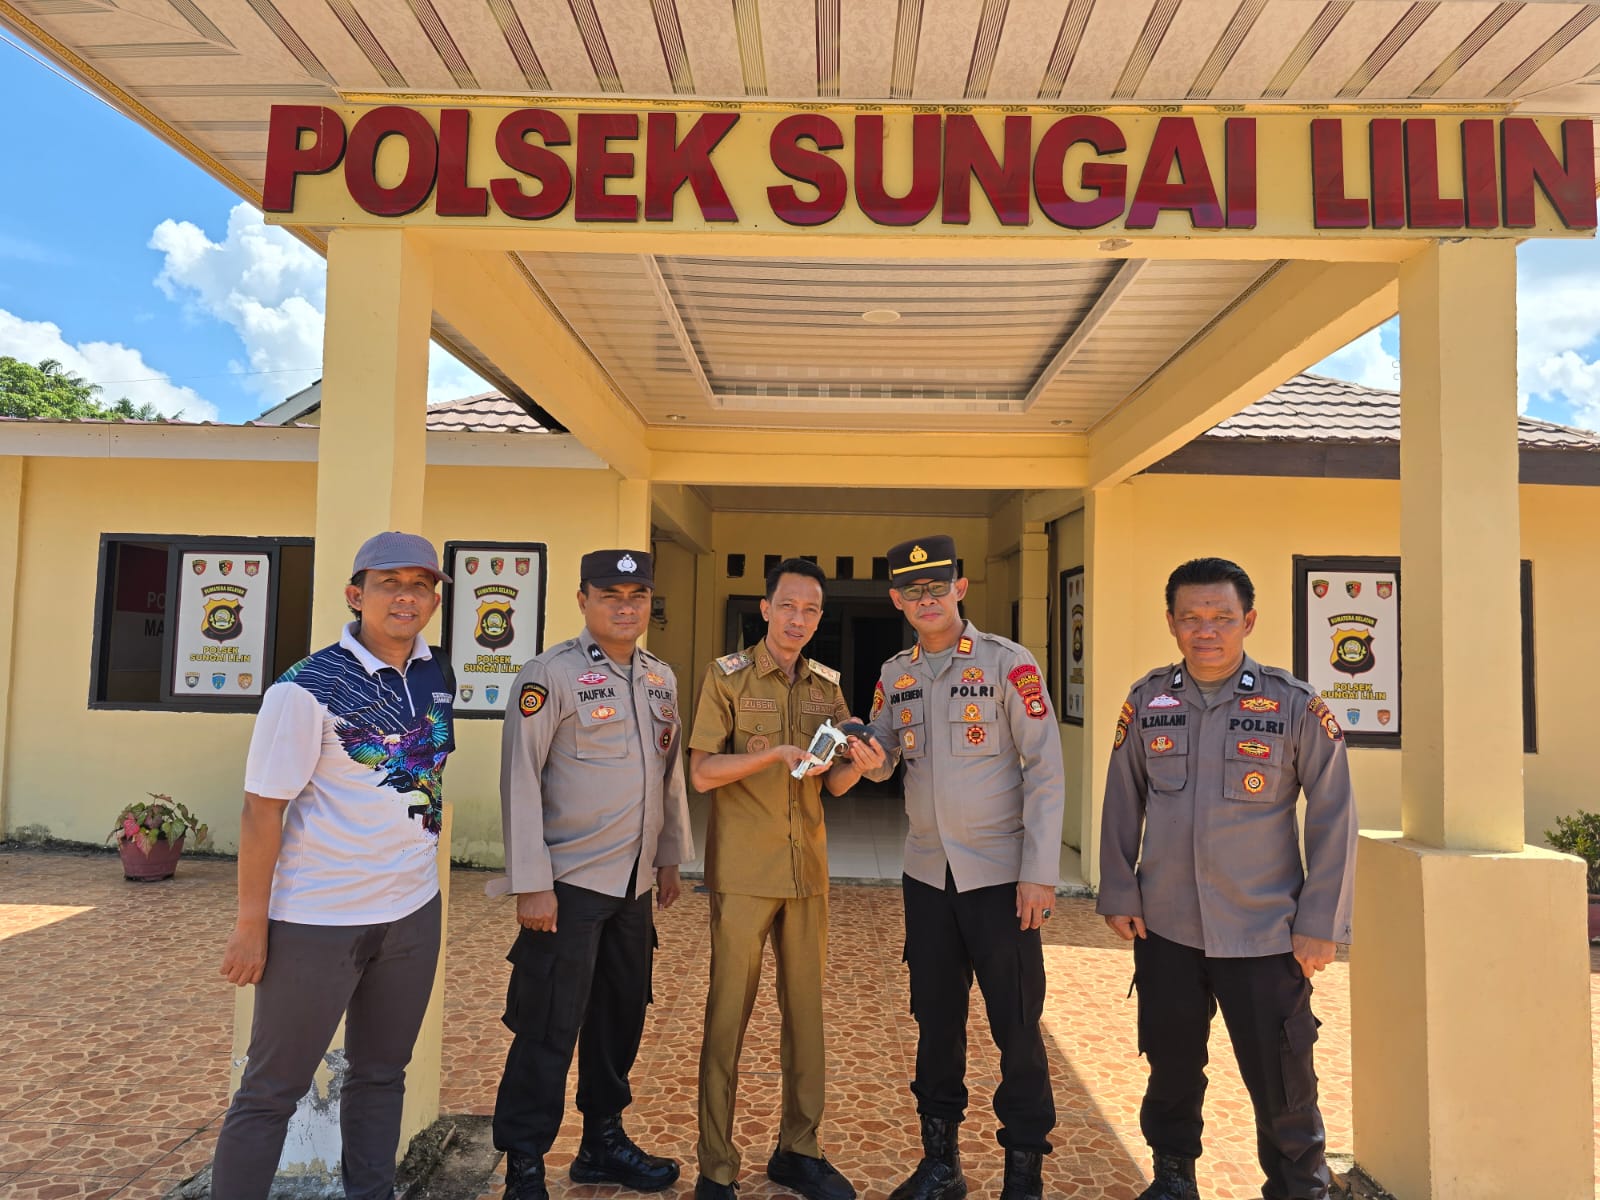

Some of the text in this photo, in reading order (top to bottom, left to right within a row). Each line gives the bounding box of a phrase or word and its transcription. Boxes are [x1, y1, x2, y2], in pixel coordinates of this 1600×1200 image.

[263, 104, 1598, 230] POLSEK SUNGAI LILIN
[190, 654, 226, 662] SUNGAI
[476, 655, 511, 664] POLSEK
[464, 663, 499, 673] SUNGAI
[950, 685, 994, 698] POLRI
[1333, 682, 1373, 691] POLSEK
[648, 689, 672, 701] POLRI
[1321, 690, 1387, 700] SUNGAI LILIN
[1229, 718, 1285, 735] POLRI
